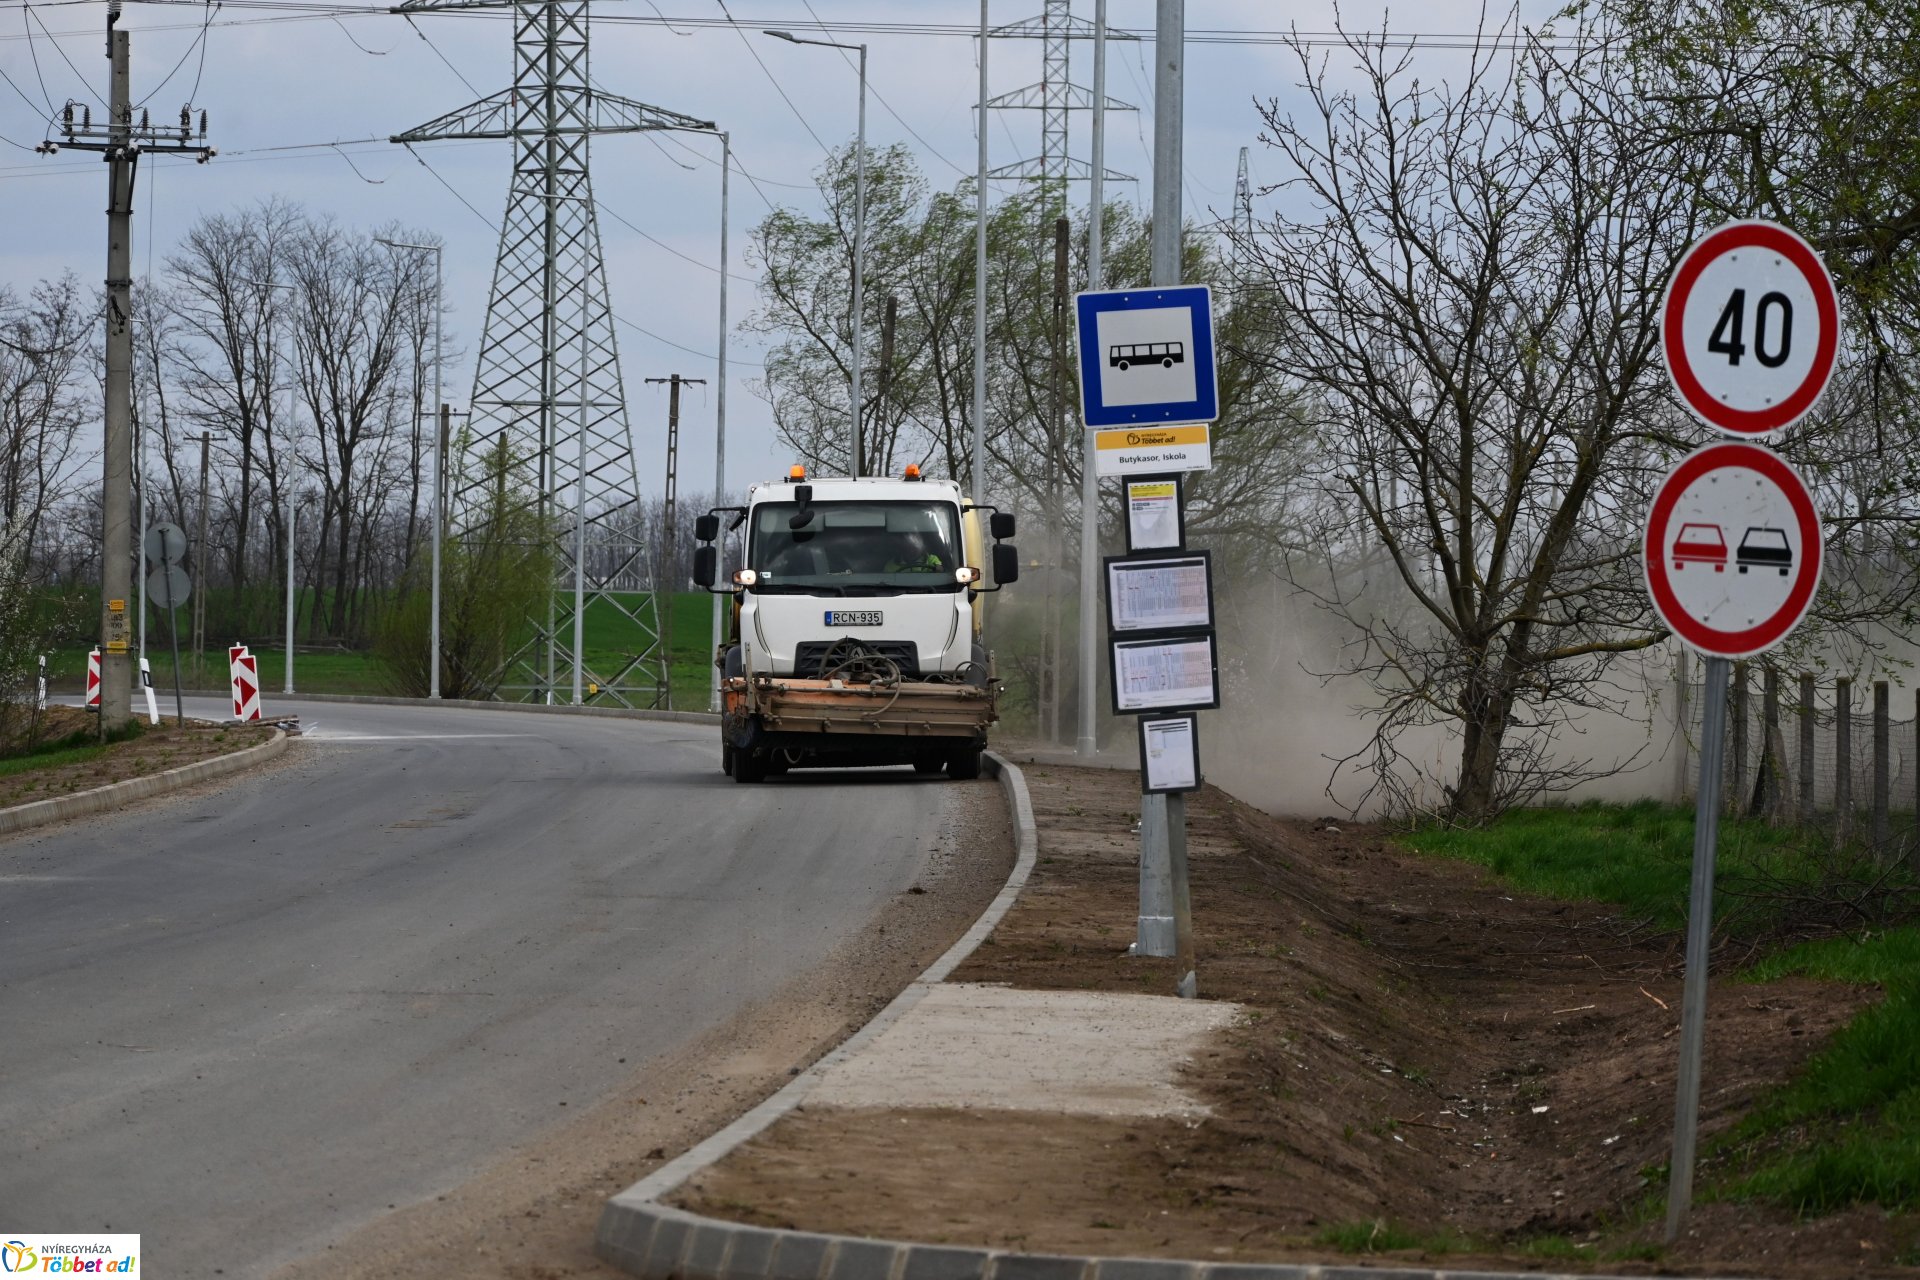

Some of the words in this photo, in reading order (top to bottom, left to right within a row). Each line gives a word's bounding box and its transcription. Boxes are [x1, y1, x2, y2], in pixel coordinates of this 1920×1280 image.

[1708, 288, 1793, 368] 40
[1119, 455, 1160, 464] Butykasor,
[1162, 453, 1186, 461] Iskola
[833, 613, 880, 622] RCN-935
